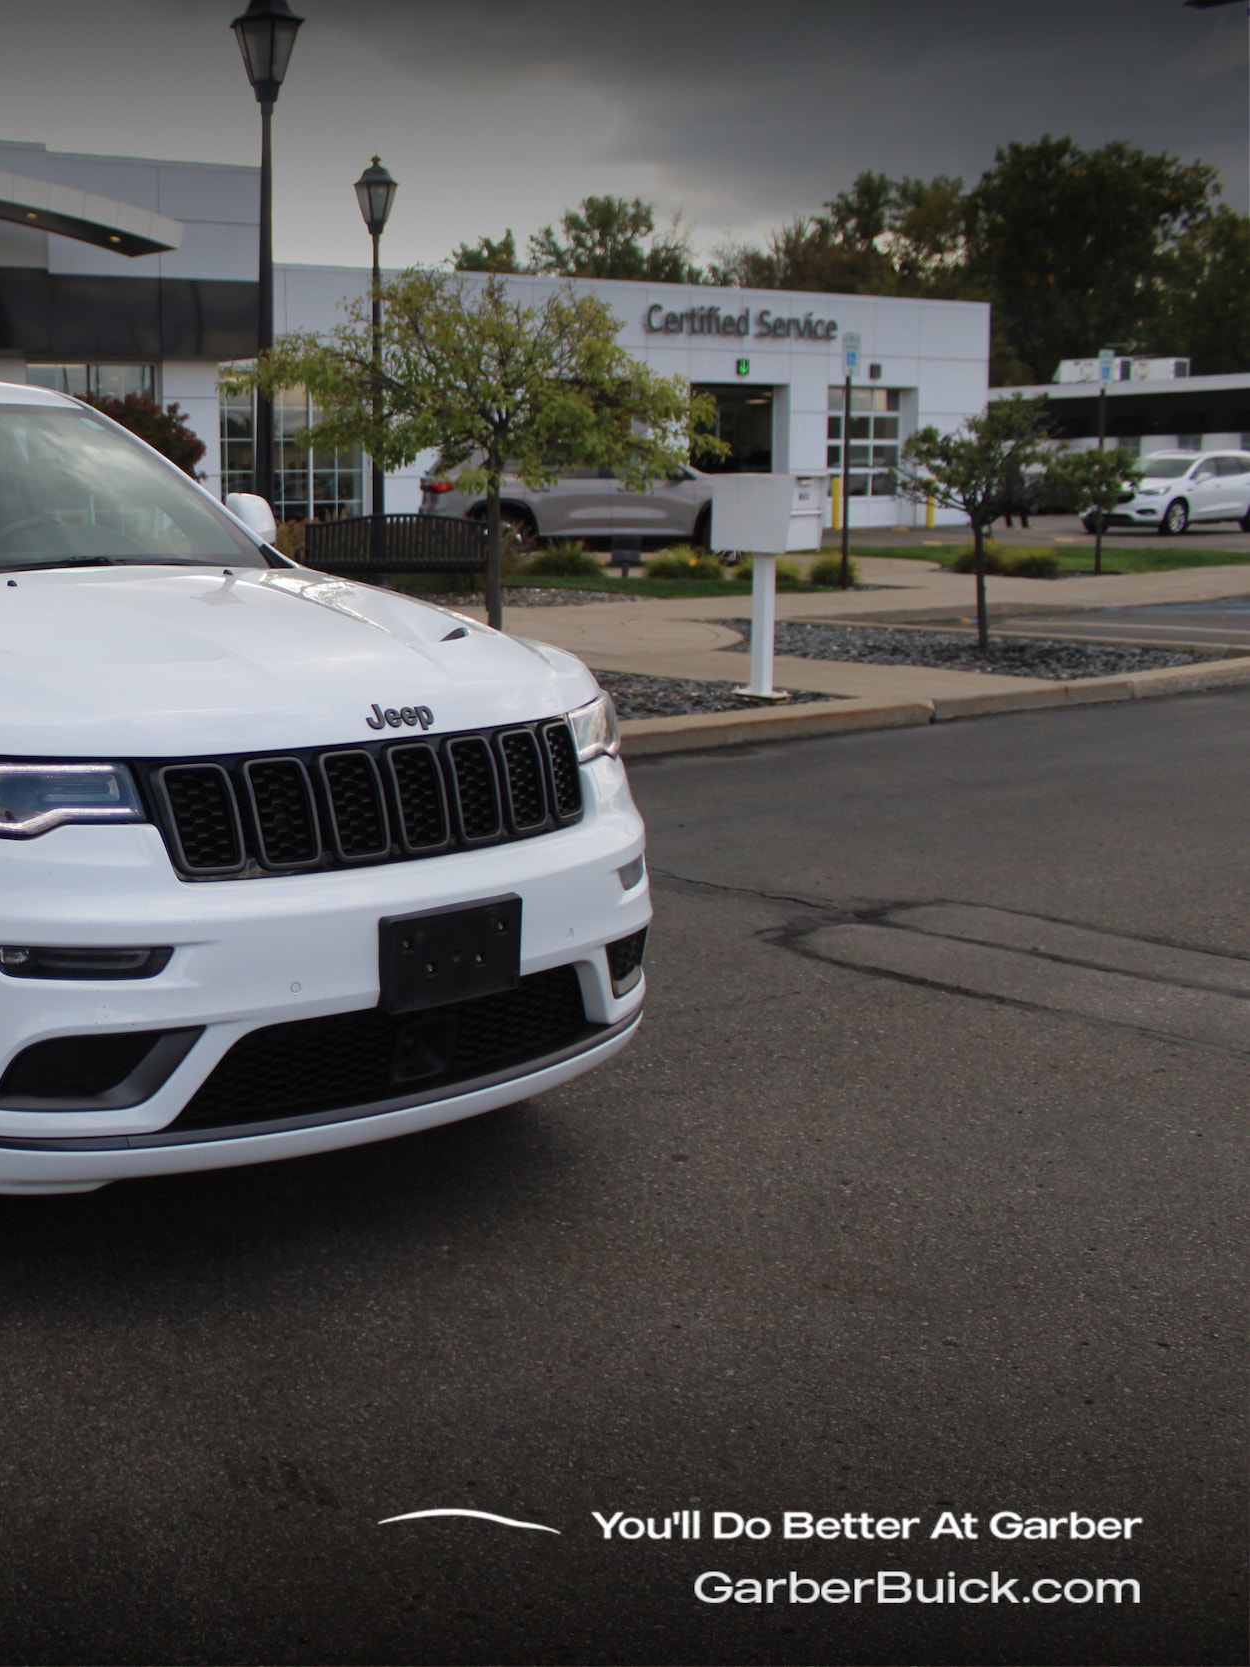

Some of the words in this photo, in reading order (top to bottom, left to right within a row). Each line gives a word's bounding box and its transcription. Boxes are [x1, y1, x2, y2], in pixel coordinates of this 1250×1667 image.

[647, 303, 749, 335] Certified
[756, 310, 838, 340] Service
[366, 703, 434, 730] Jeep
